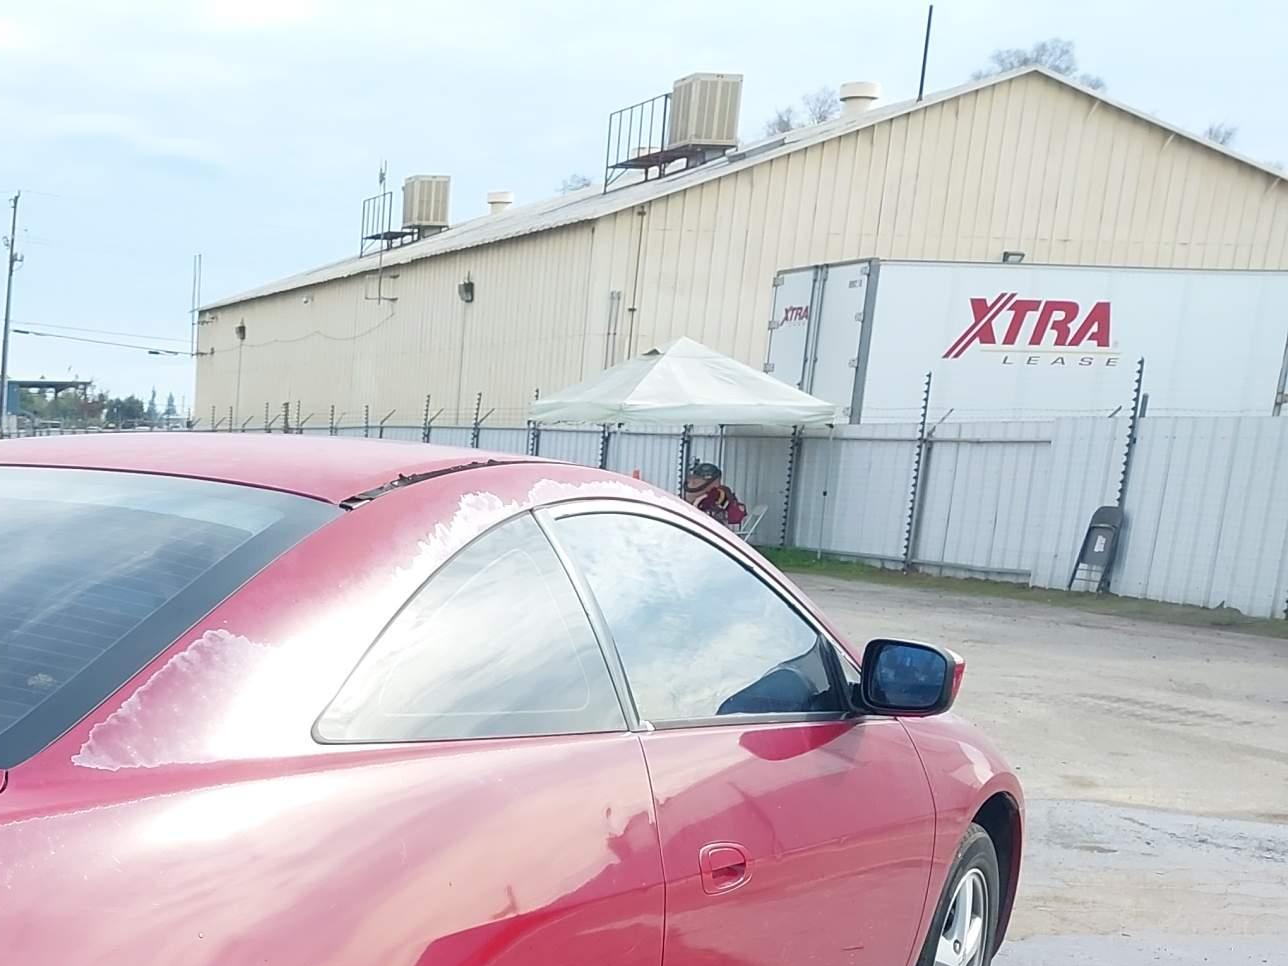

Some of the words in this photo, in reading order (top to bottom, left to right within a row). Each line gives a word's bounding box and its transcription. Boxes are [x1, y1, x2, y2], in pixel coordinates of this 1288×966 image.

[779, 304, 810, 327] XTRA
[942, 292, 1111, 359] XTRA
[1001, 355, 1121, 367] LEASE
